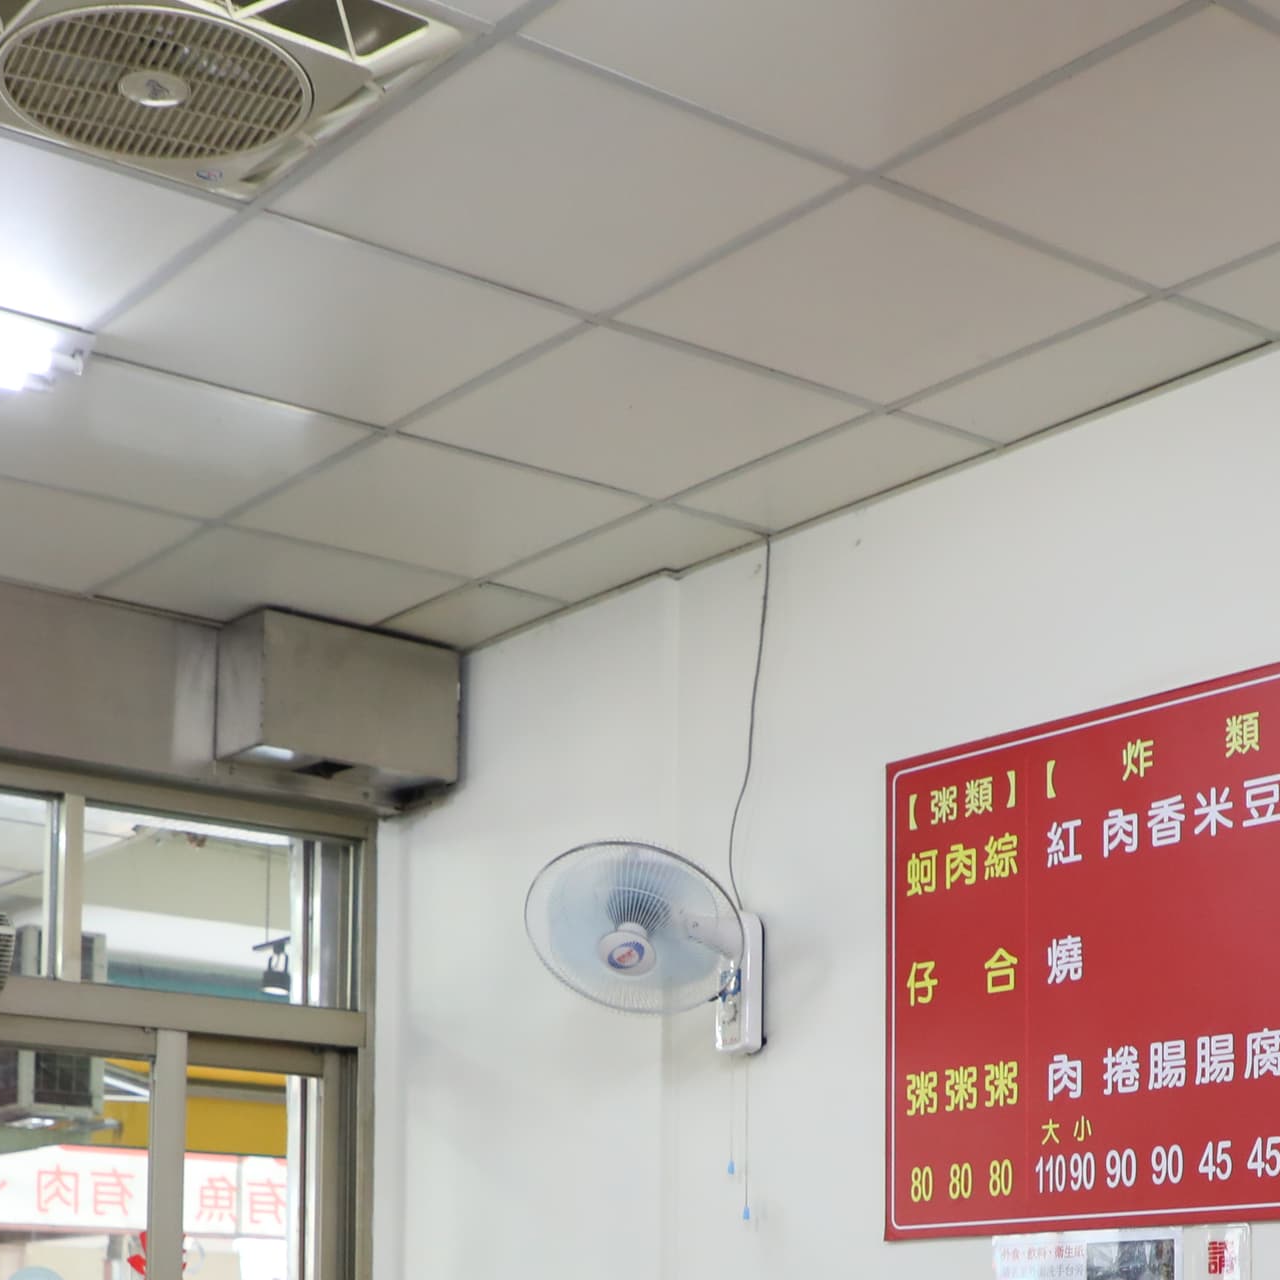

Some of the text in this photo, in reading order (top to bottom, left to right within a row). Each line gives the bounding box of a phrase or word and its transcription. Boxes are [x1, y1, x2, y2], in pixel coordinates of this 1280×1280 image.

[908, 772, 1017, 830] 【粥類】
[1041, 1115, 1092, 1145] 大 小
[910, 1165, 933, 1203] 80
[948, 1162, 973, 1200] 80
[988, 1158, 1013, 1197] 80
[1035, 1154, 1066, 1194] 110
[1069, 1151, 1096, 1191] 90
[1105, 1148, 1137, 1189] 90
[1151, 1144, 1184, 1185] 90
[1198, 1140, 1233, 1182] 45
